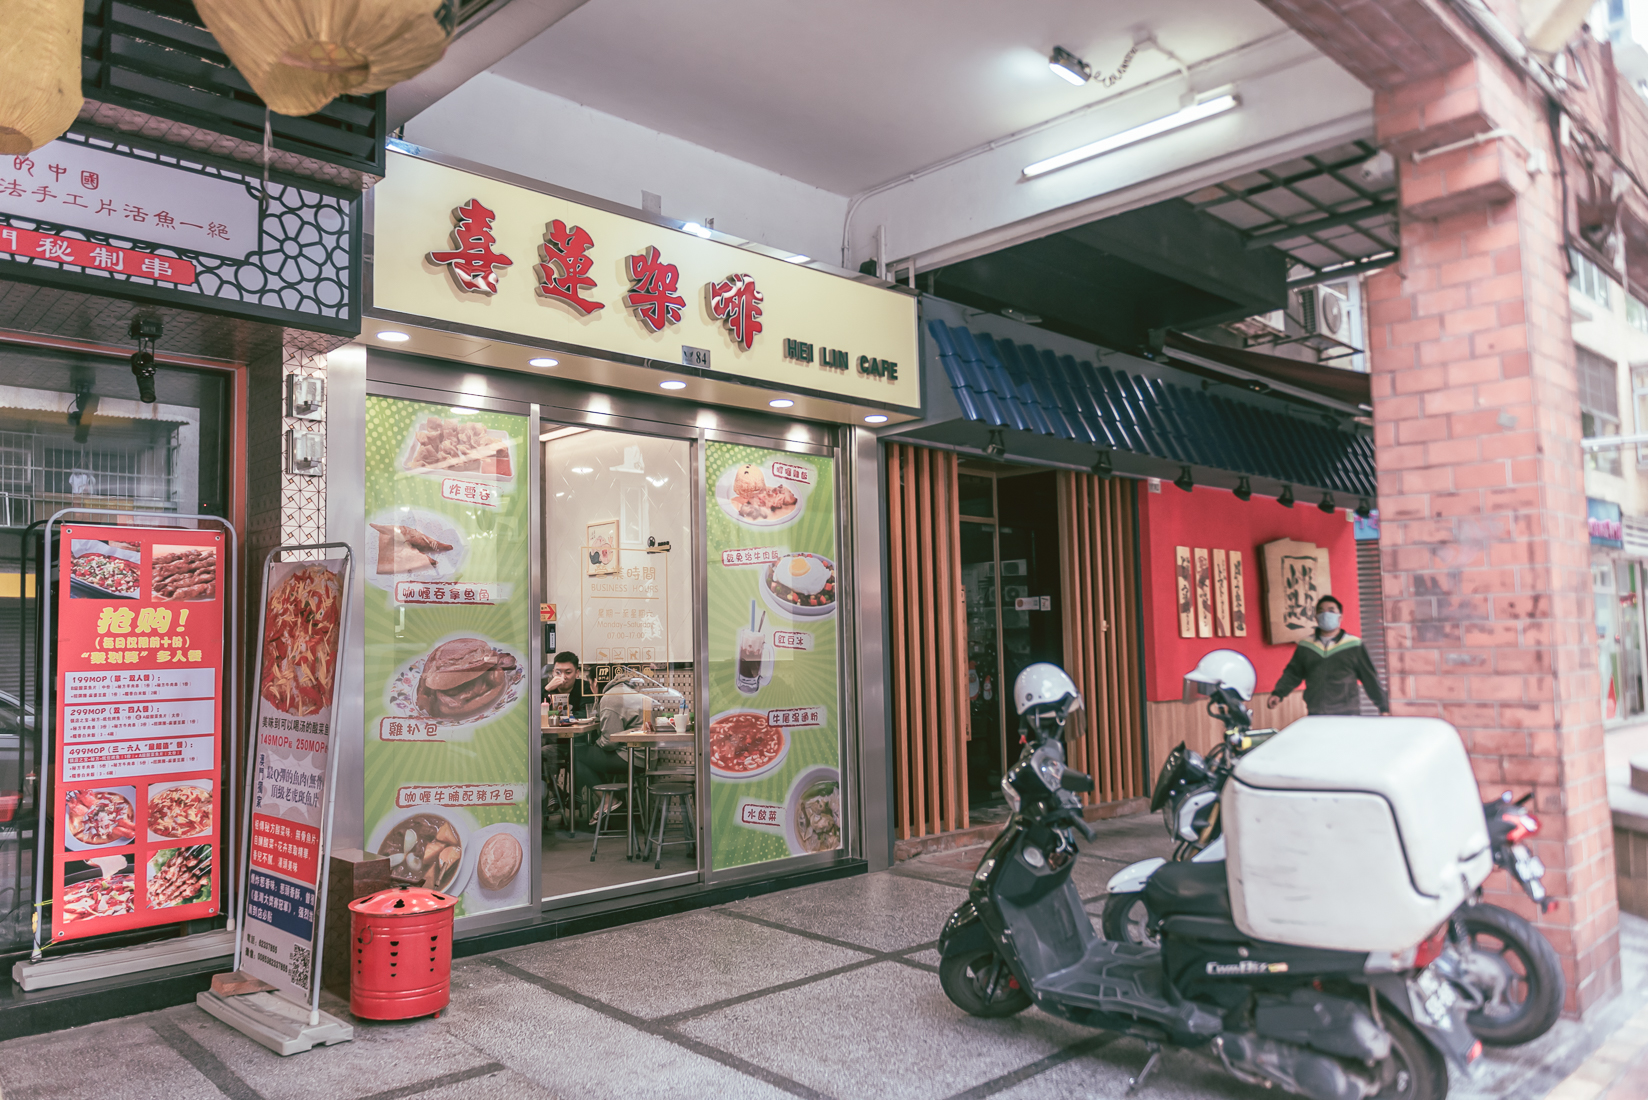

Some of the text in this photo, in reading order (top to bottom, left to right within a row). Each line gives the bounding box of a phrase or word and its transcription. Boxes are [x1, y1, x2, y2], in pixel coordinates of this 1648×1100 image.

[0, 178, 231, 242] 法手工片活魚一絕
[695, 351, 707, 365] 84
[784, 338, 898, 381] HEI LIN CAFE
[595, 565, 656, 581] 營業時間
[591, 583, 659, 593] BUSINESS HOURS
[389, 721, 438, 737] 雞扒包
